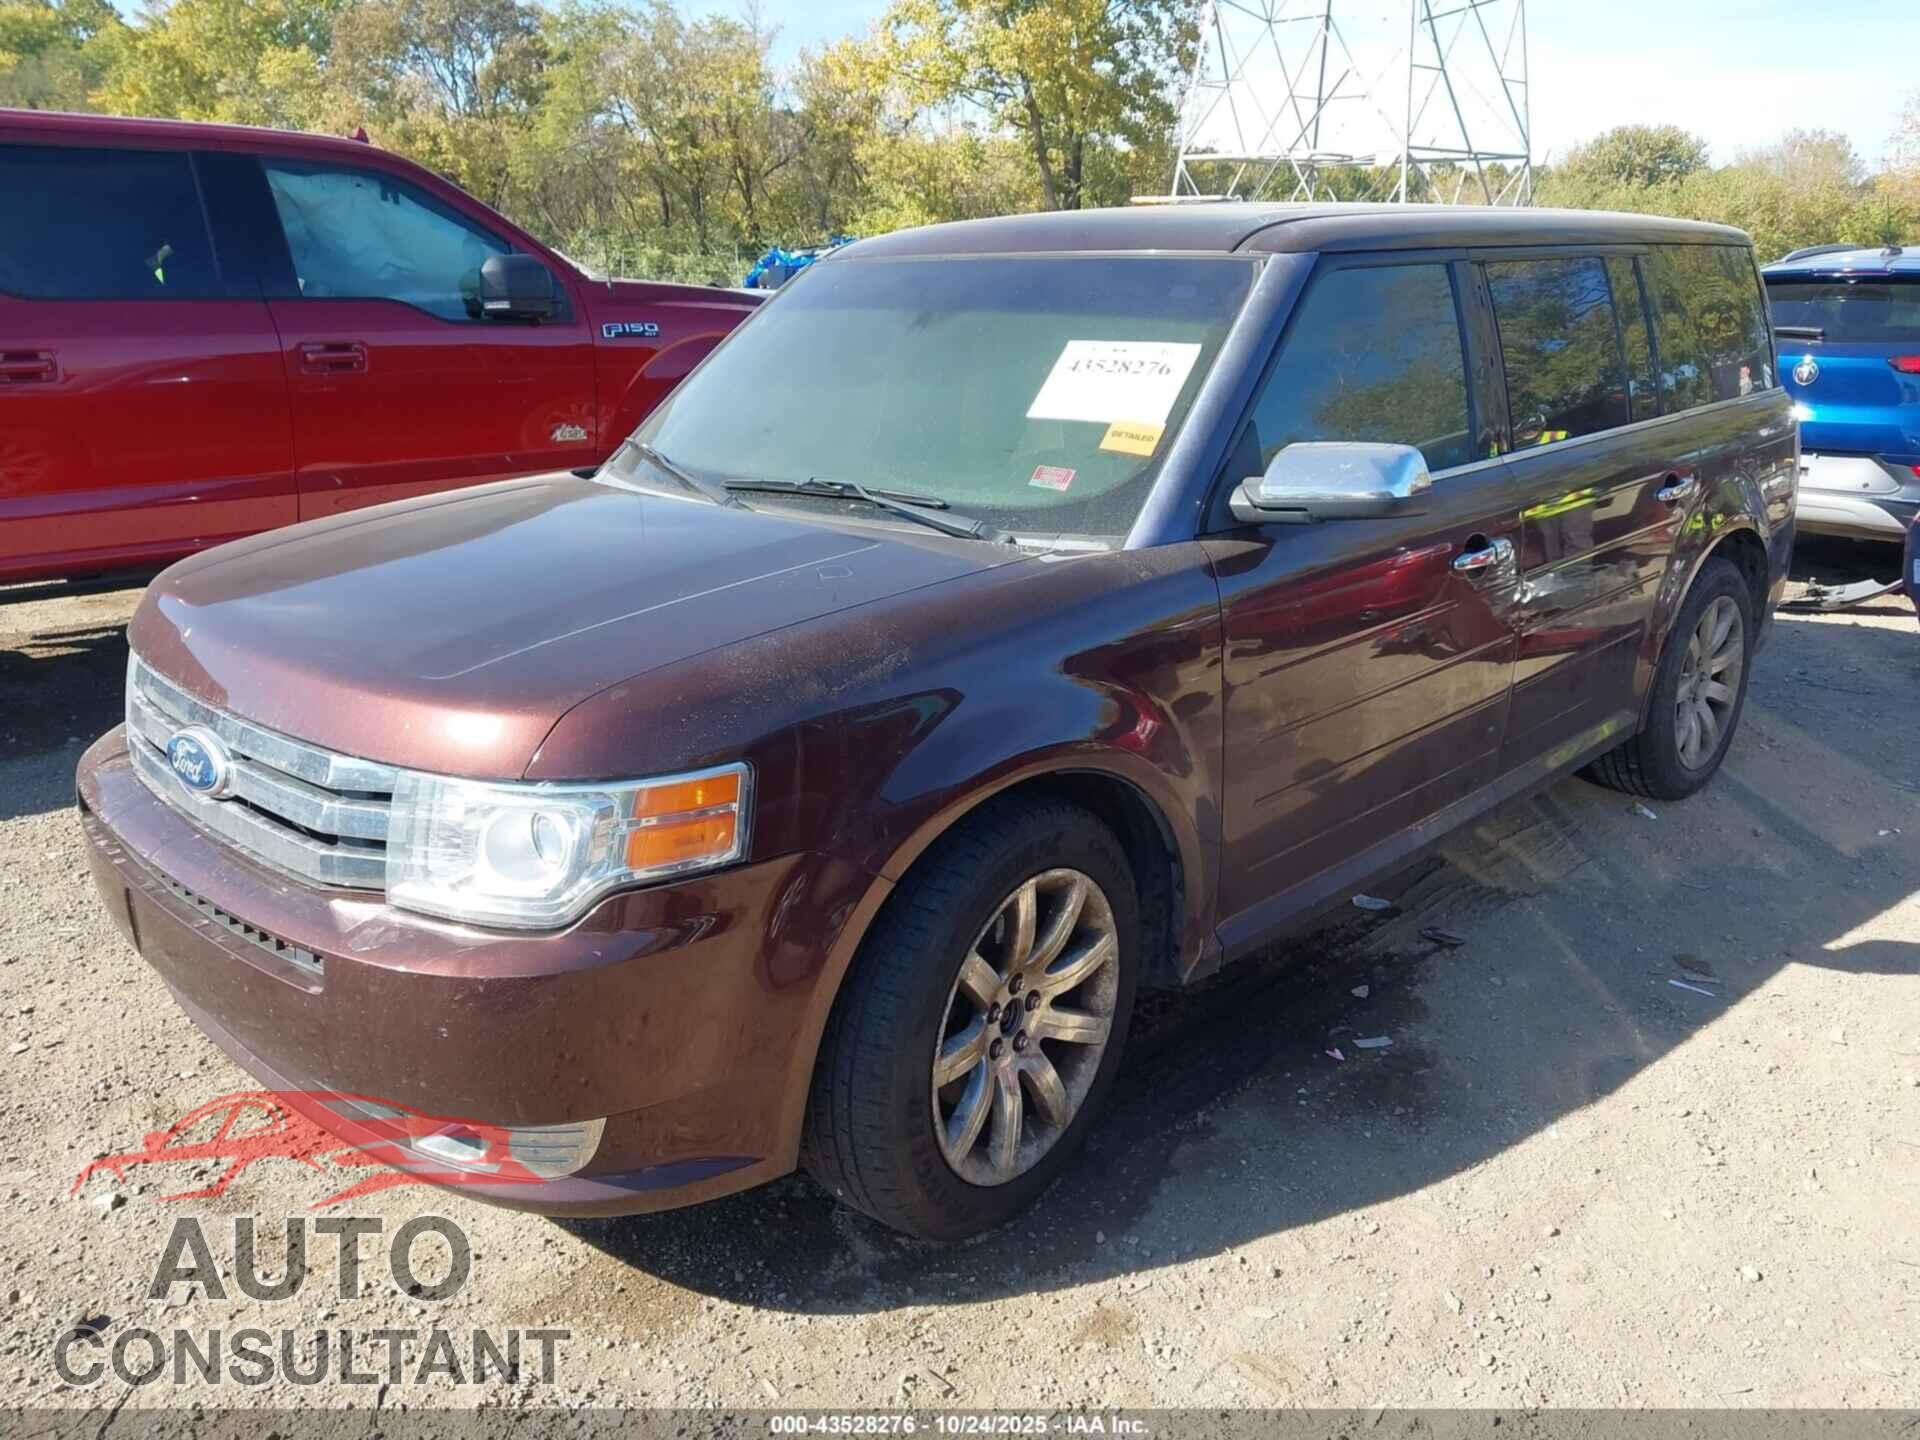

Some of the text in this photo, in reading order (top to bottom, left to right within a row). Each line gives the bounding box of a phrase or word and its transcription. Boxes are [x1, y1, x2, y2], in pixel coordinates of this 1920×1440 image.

[602, 322, 659, 338] F150
[1069, 359, 1172, 376] 43528276
[1111, 430, 1155, 443] DETAILED
[172, 739, 205, 784] Ford
